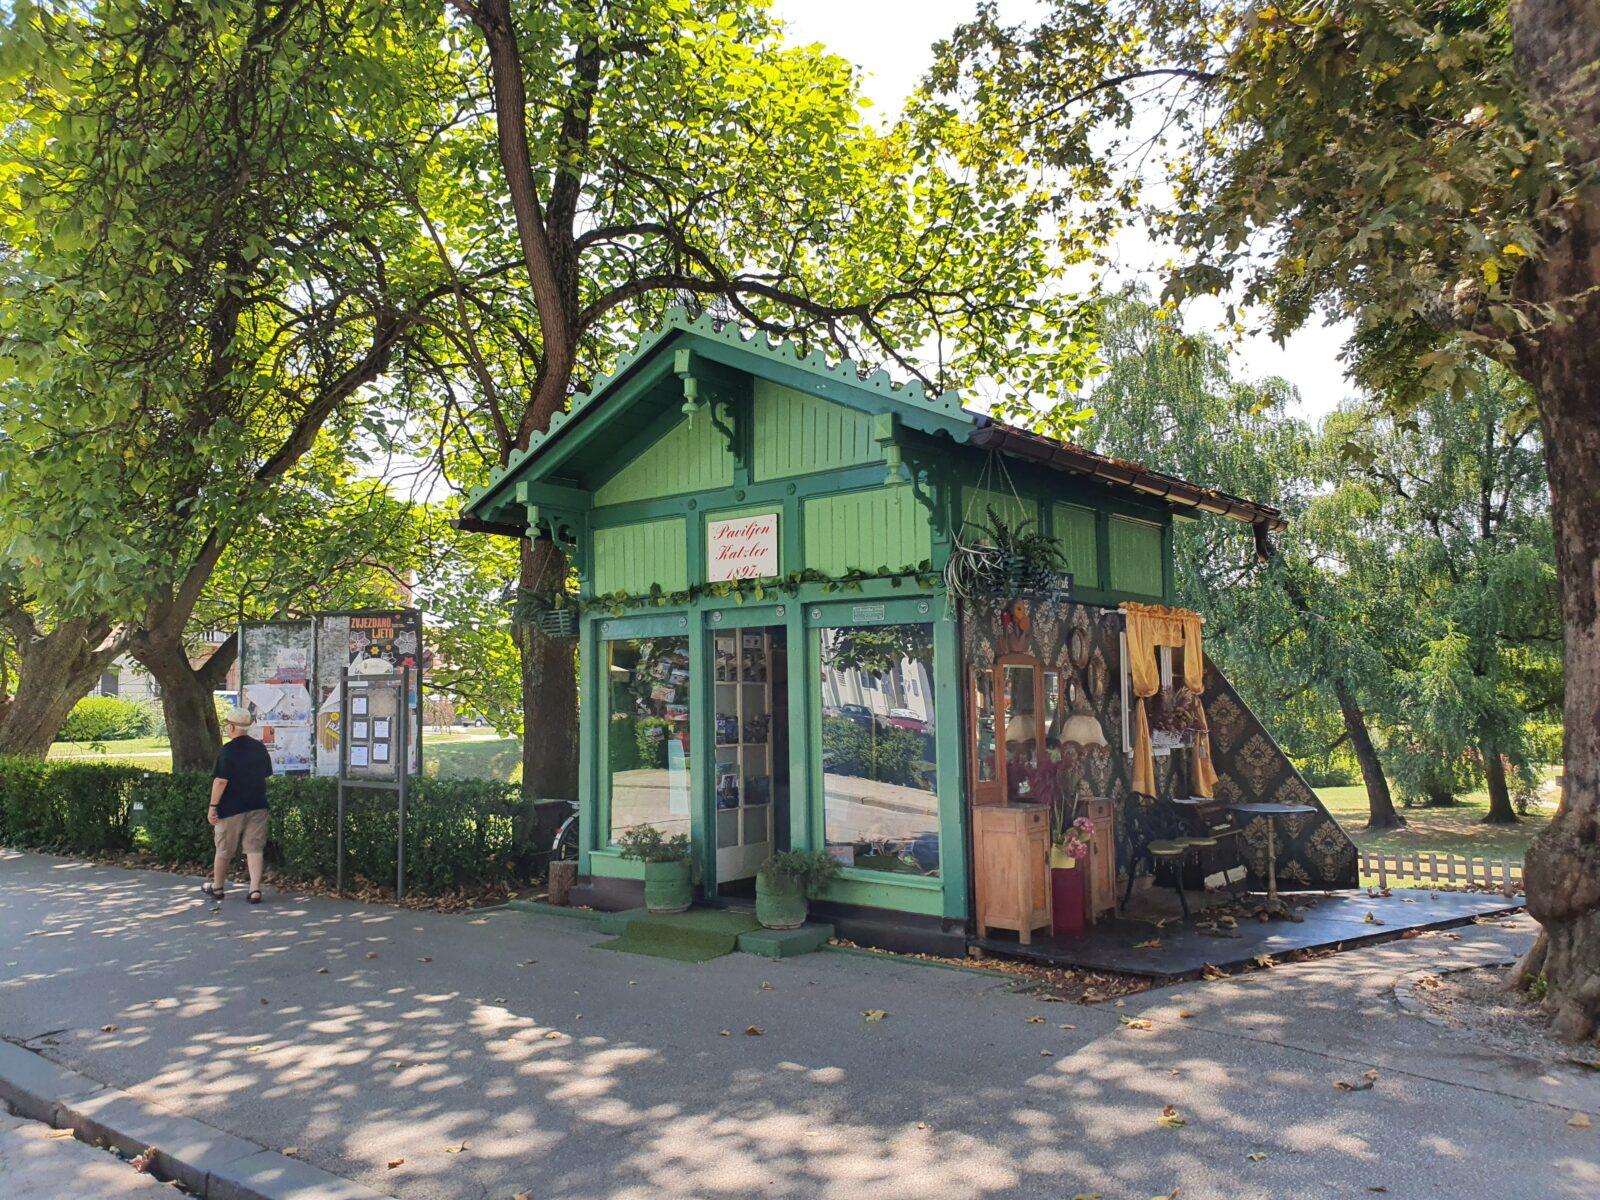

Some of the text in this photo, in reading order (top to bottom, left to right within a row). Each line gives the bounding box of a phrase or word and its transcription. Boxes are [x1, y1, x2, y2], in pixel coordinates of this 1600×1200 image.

[713, 521, 770, 540] Paviljon
[715, 542, 769, 561] Katzler
[351, 618, 391, 628] ZVJEZDANO
[372, 628, 394, 638] LJETO
